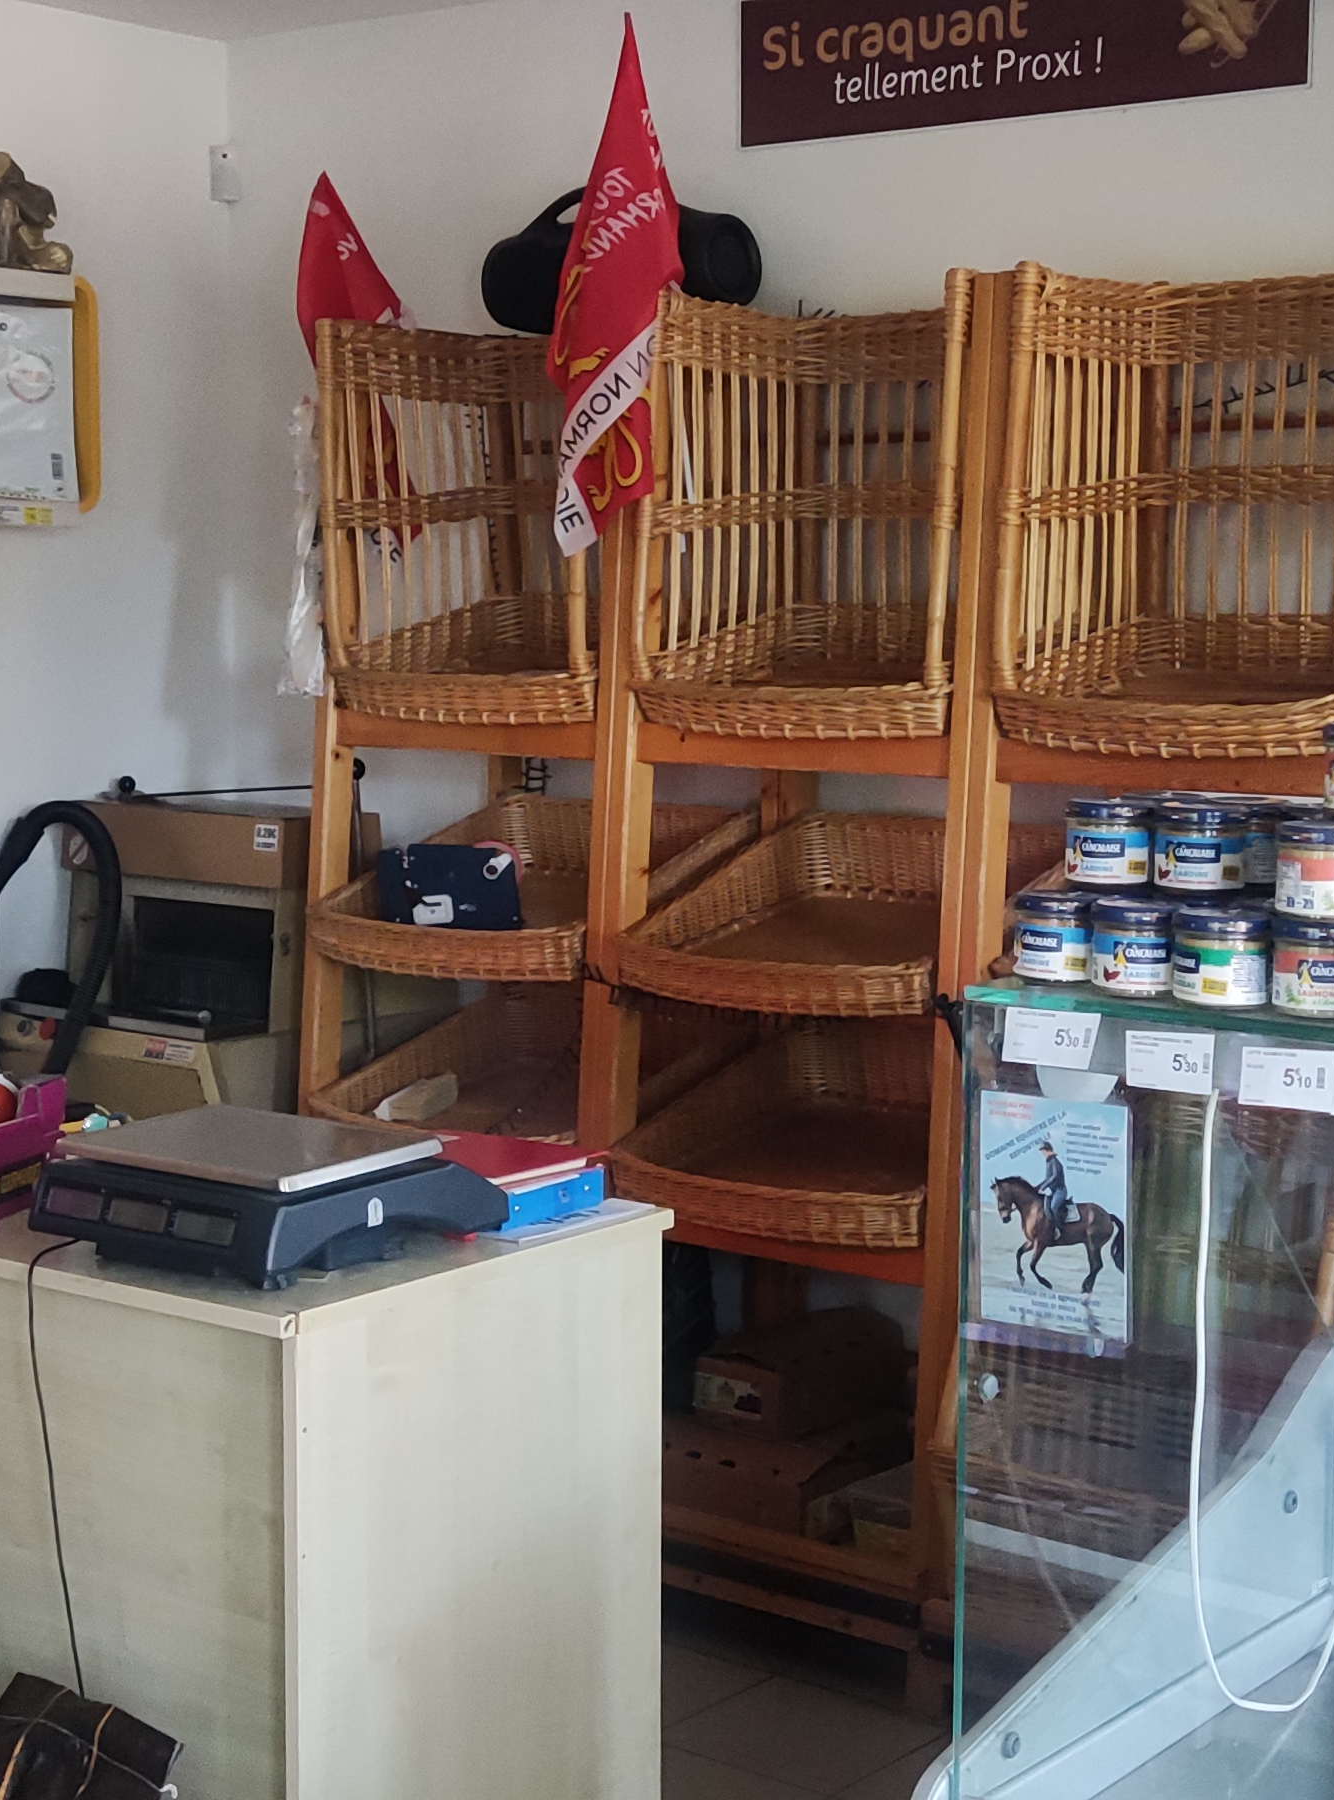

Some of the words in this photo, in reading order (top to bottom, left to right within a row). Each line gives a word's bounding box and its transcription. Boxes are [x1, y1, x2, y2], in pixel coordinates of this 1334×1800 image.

[762, 21, 805, 71] Si
[816, 0, 1030, 63] craquant
[834, 53, 984, 105] tellement
[994, 40, 1083, 85] Proxi
[1094, 36, 1105, 74] !
[984, 1138, 1016, 1161] DOMAINE
[1047, 1115, 1058, 1125] DE
